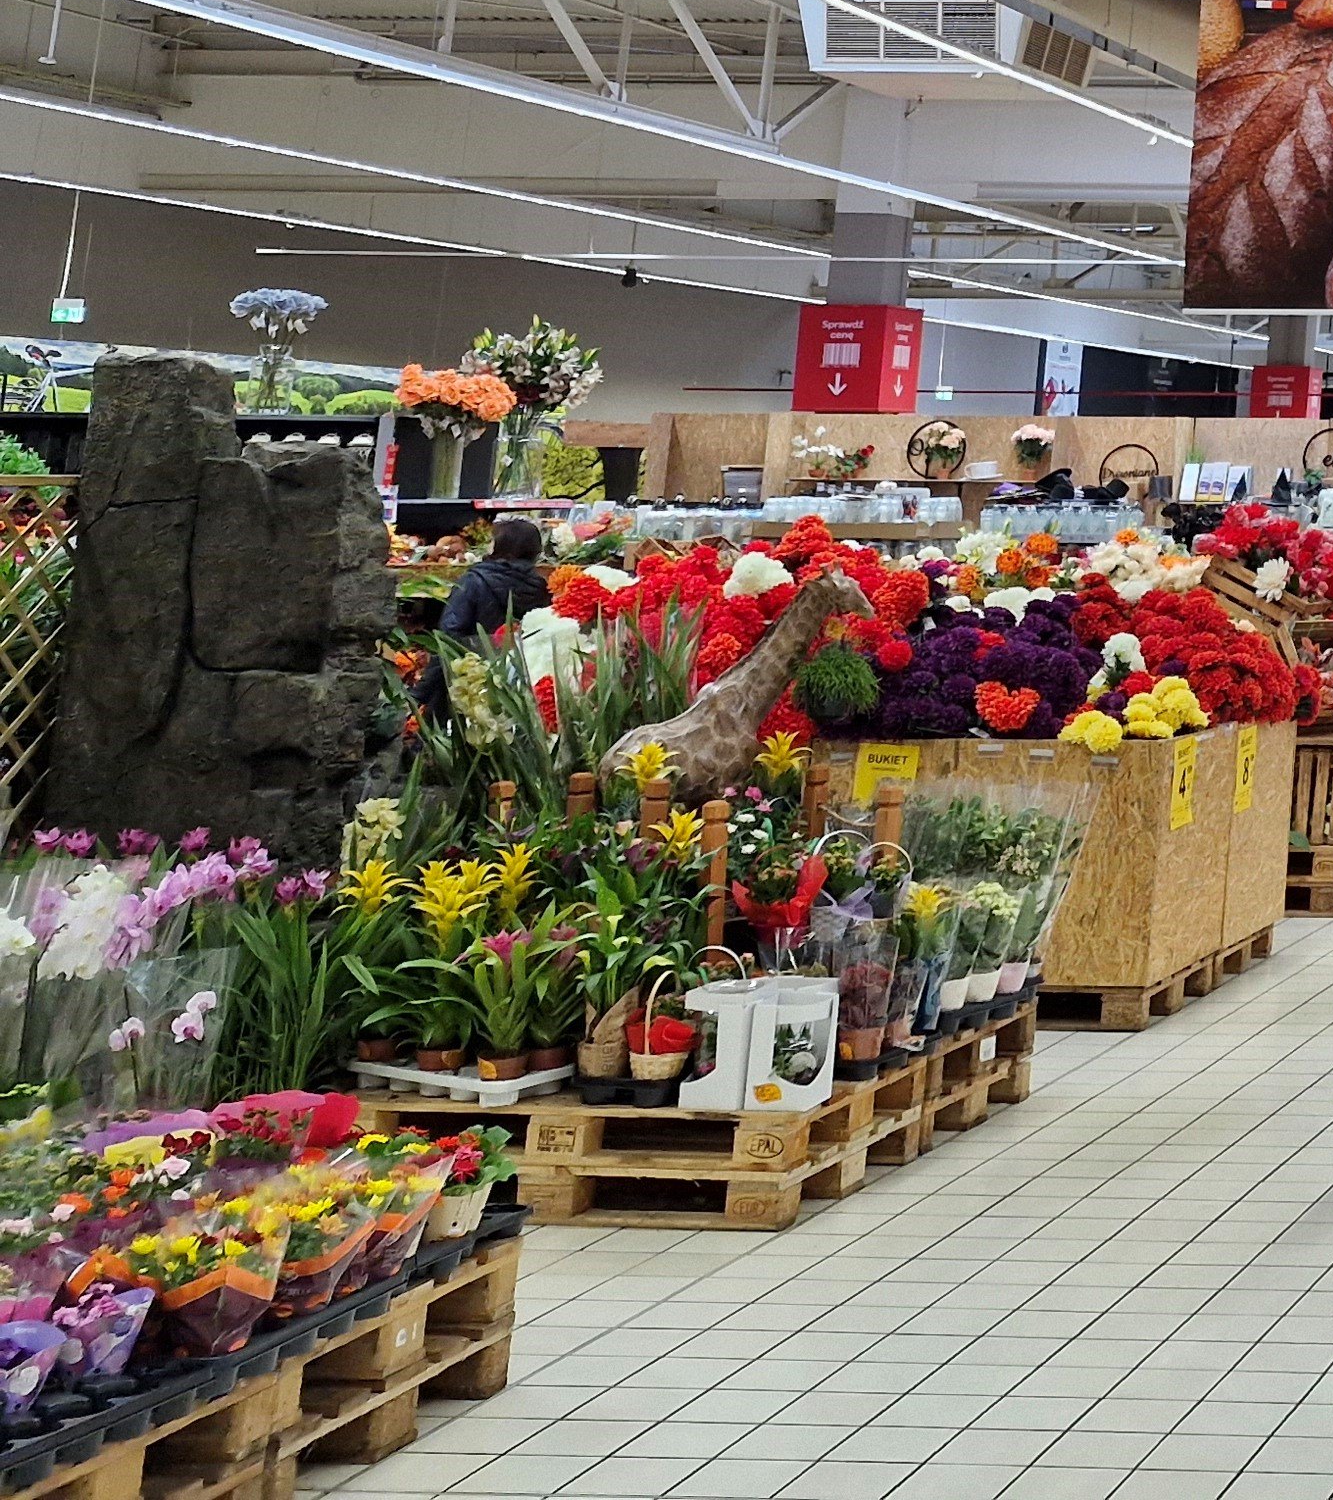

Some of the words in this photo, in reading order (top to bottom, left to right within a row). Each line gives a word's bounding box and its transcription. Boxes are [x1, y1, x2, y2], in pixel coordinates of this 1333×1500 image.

[822, 319, 864, 331] Sprawdź
[868, 753, 909, 765] BUKIET
[750, 1137, 778, 1155] EPAL
